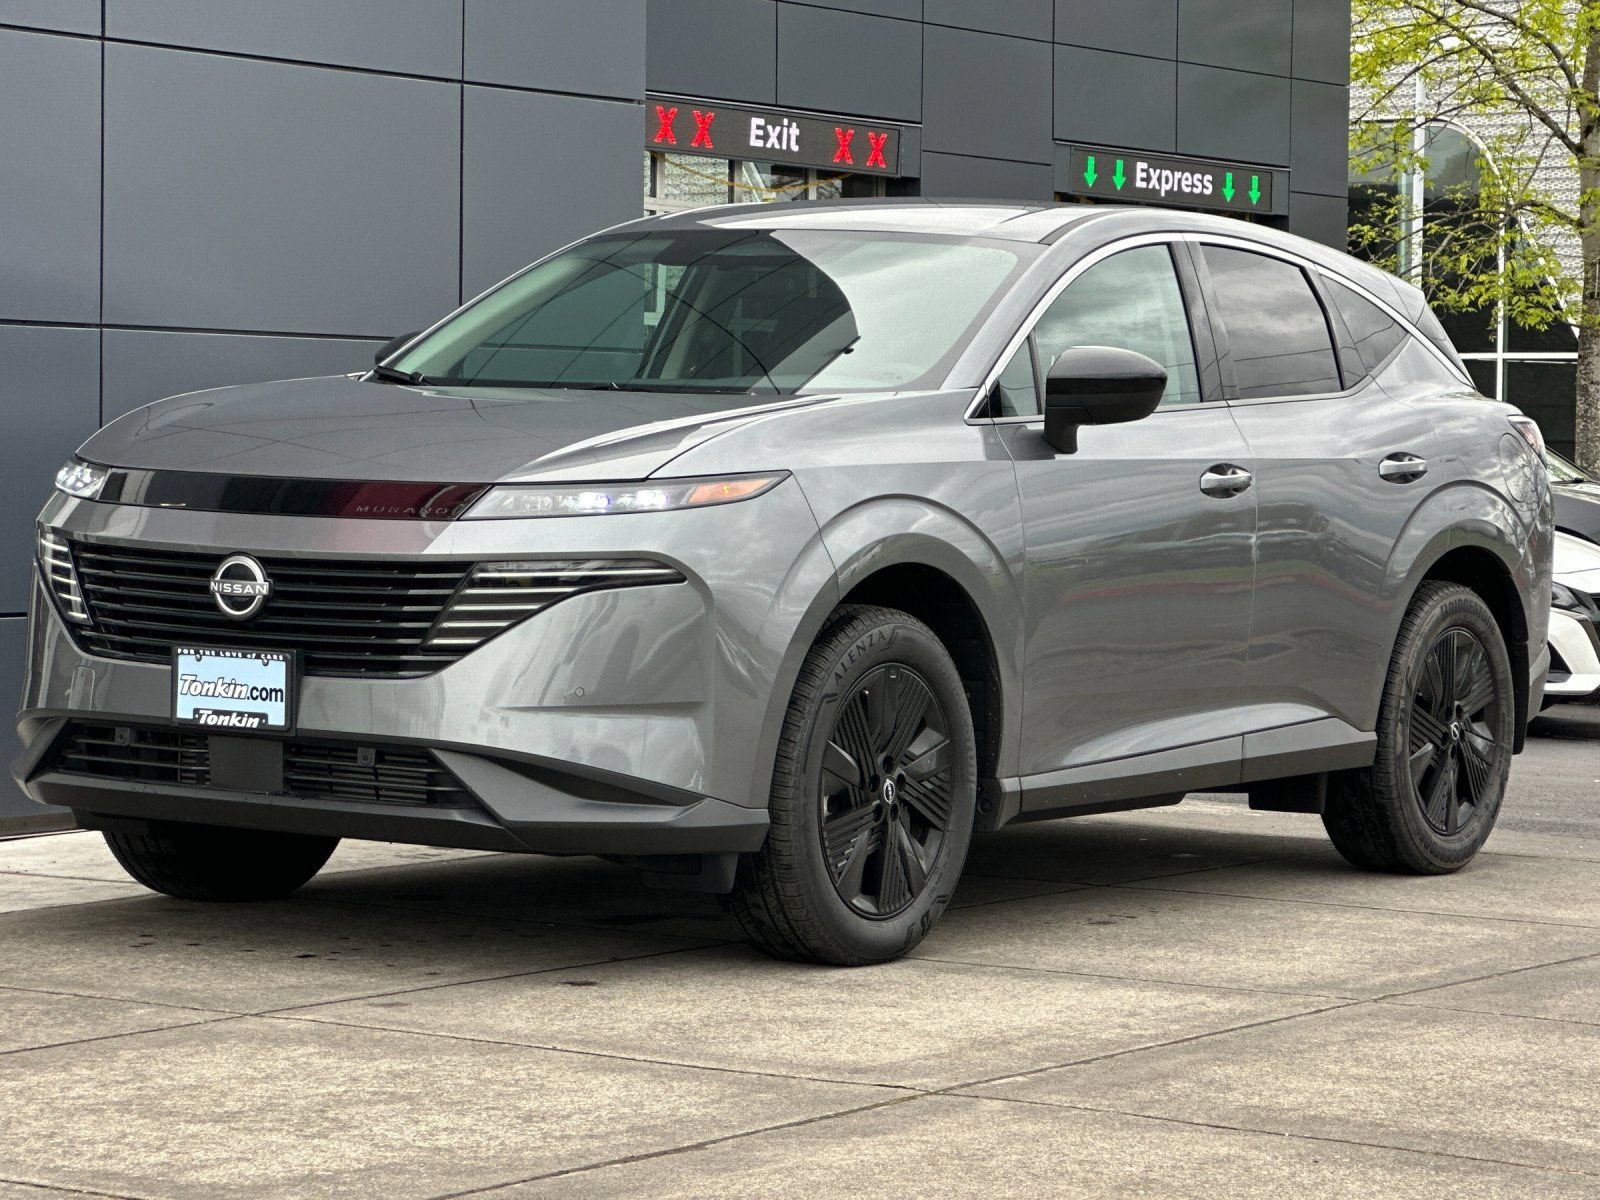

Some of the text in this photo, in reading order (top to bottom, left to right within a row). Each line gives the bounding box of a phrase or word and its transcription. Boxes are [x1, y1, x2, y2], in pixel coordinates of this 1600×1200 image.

[749, 117, 800, 152] Exit
[1135, 161, 1213, 197] Express
[356, 505, 448, 514] MURANO
[210, 581, 267, 594] NISSAN
[834, 629, 887, 686] ALENZA
[180, 673, 284, 702] Tonkin.com
[198, 709, 260, 728] Tonkin
